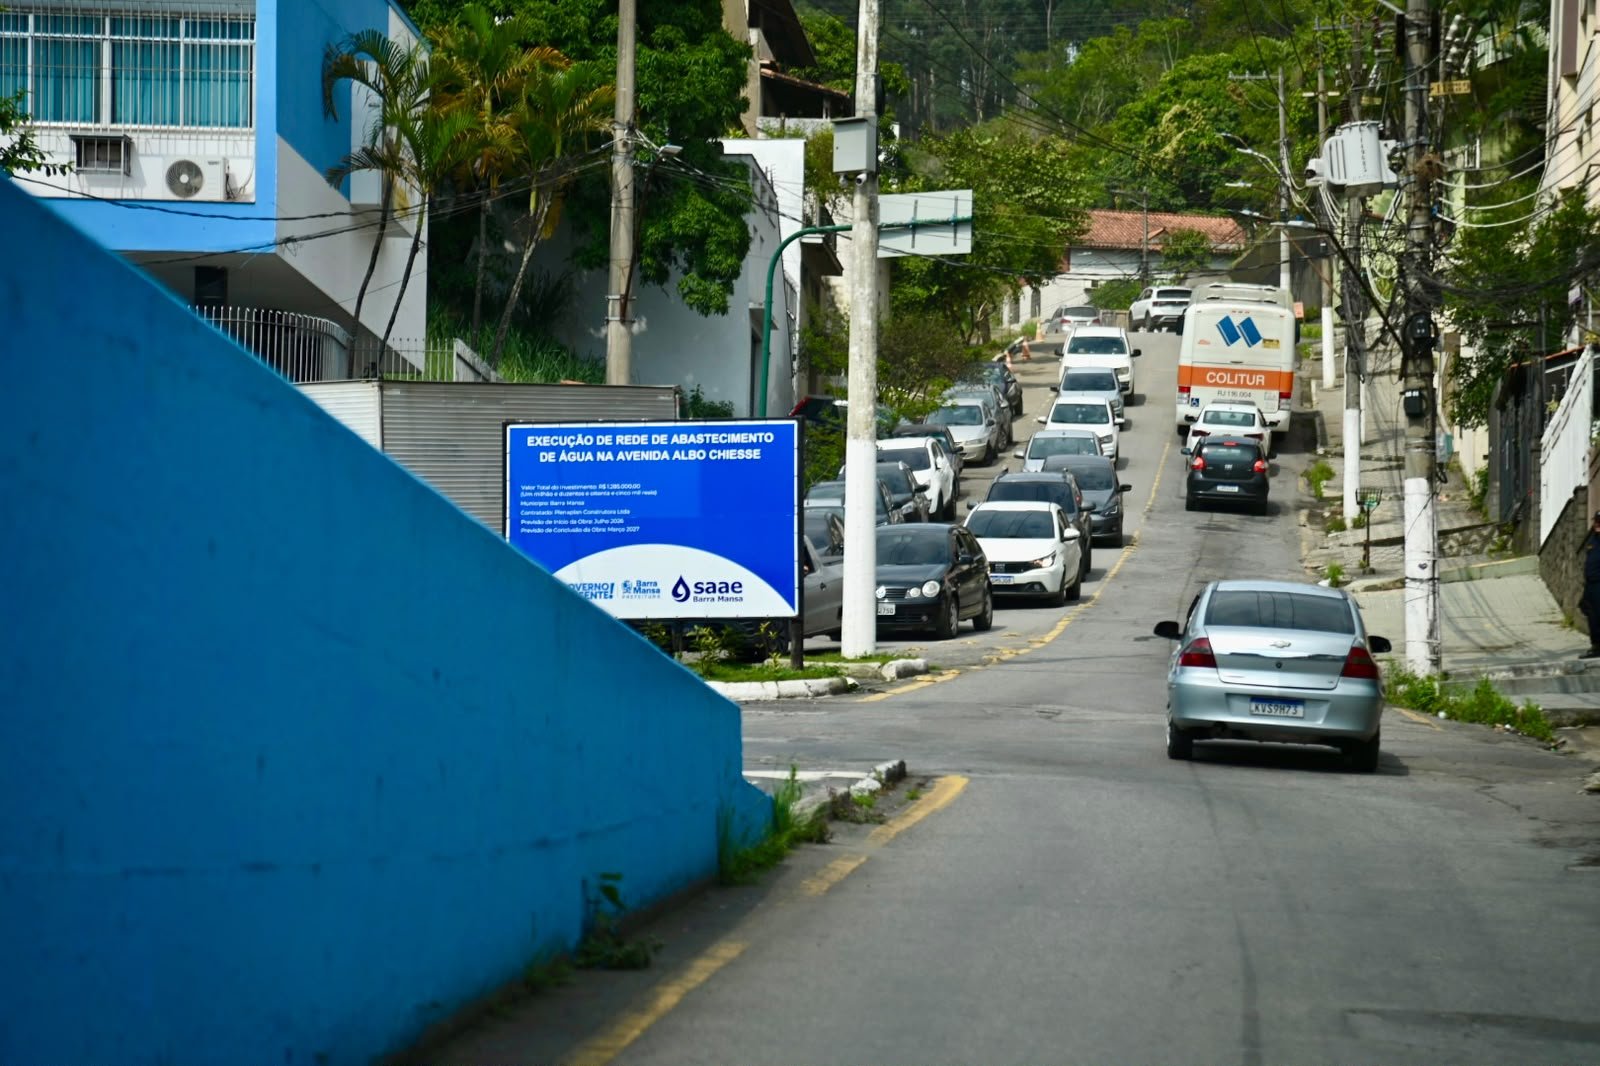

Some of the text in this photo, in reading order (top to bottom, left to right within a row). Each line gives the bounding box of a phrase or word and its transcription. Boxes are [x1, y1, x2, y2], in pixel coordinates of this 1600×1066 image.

[1206, 371, 1265, 386] COLITUR
[527, 432, 774, 448] EXECUÇÃO DE REDE DE ABASTECIMENTO
[539, 448, 761, 462] DE ÁGUA NA AVENIDA ALBO CHIESSE
[567, 583, 610, 591] OVERNO
[693, 581, 743, 594] saae
[1254, 703, 1298, 715] KVS9H73
